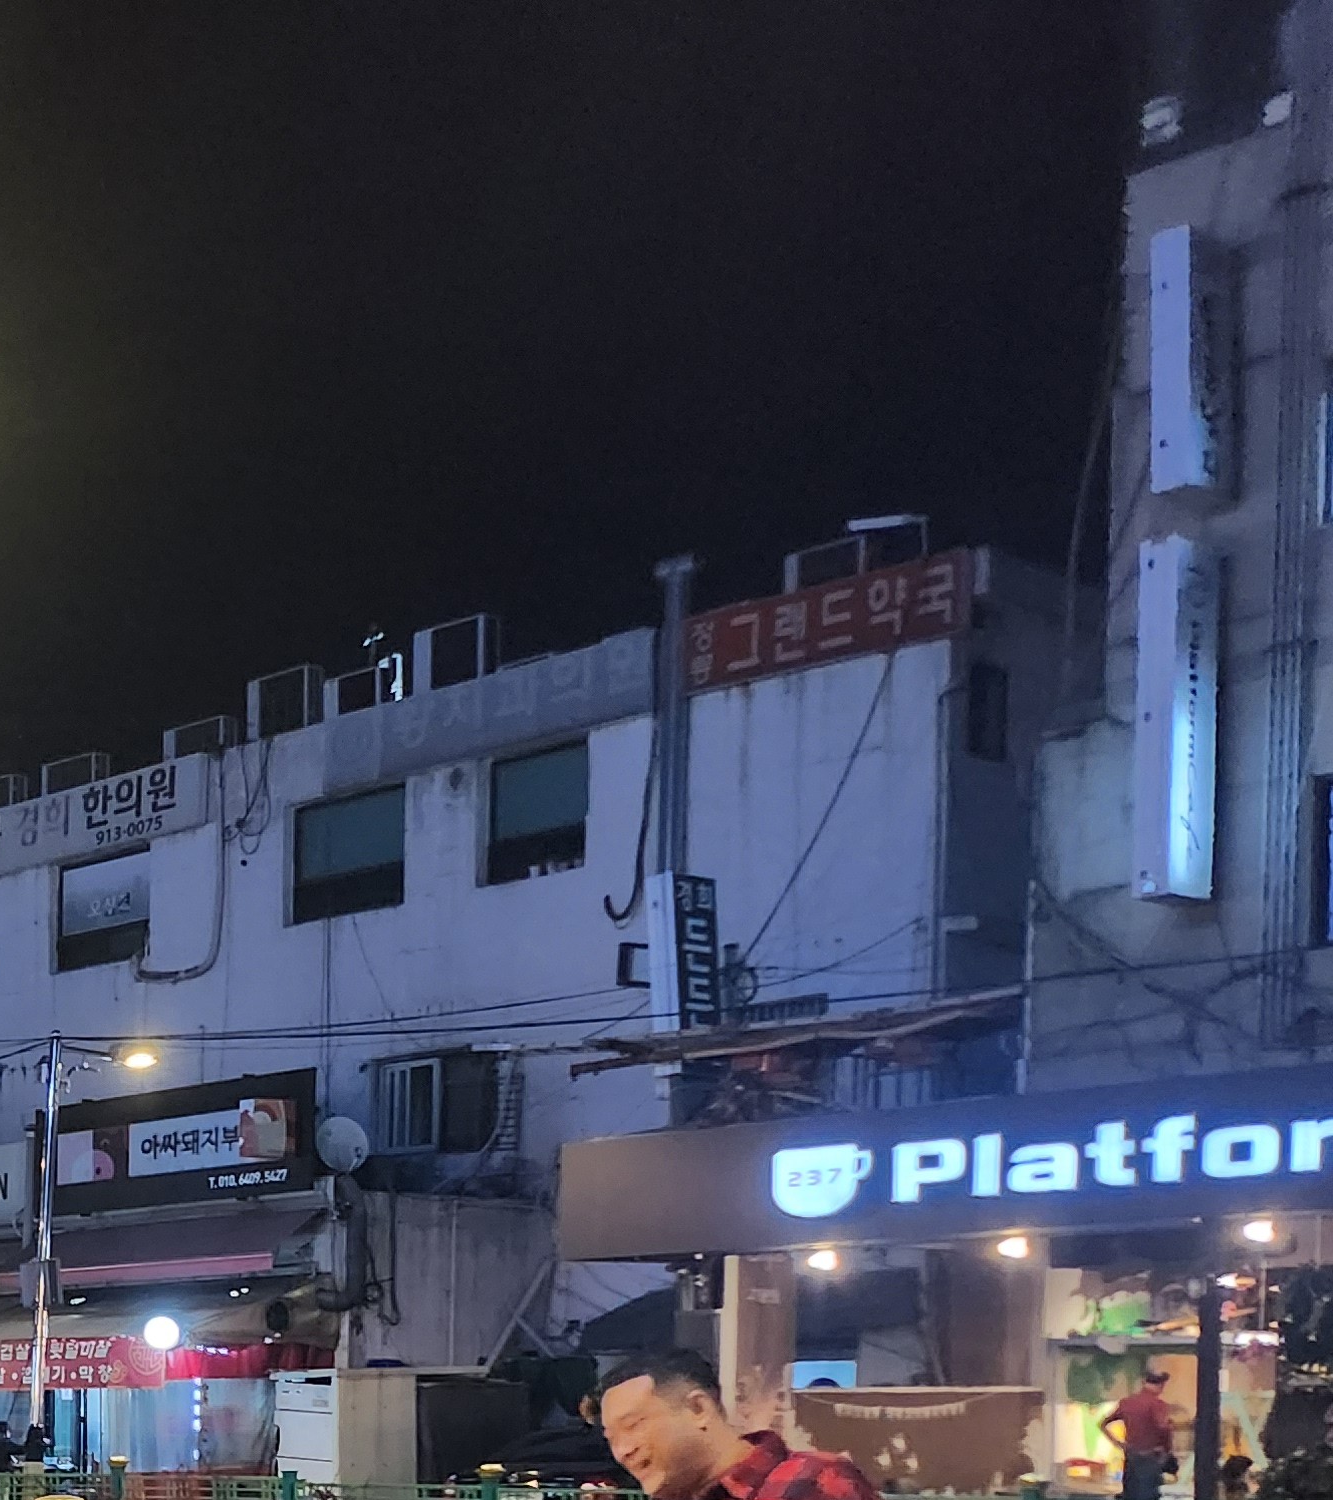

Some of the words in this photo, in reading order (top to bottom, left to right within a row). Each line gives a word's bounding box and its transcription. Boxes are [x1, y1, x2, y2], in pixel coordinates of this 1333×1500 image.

[727, 563, 955, 673] 그랜드약국
[82, 765, 177, 830] 한의원
[95, 815, 163, 846] 913-0075
[787, 1168, 843, 1188] 237
